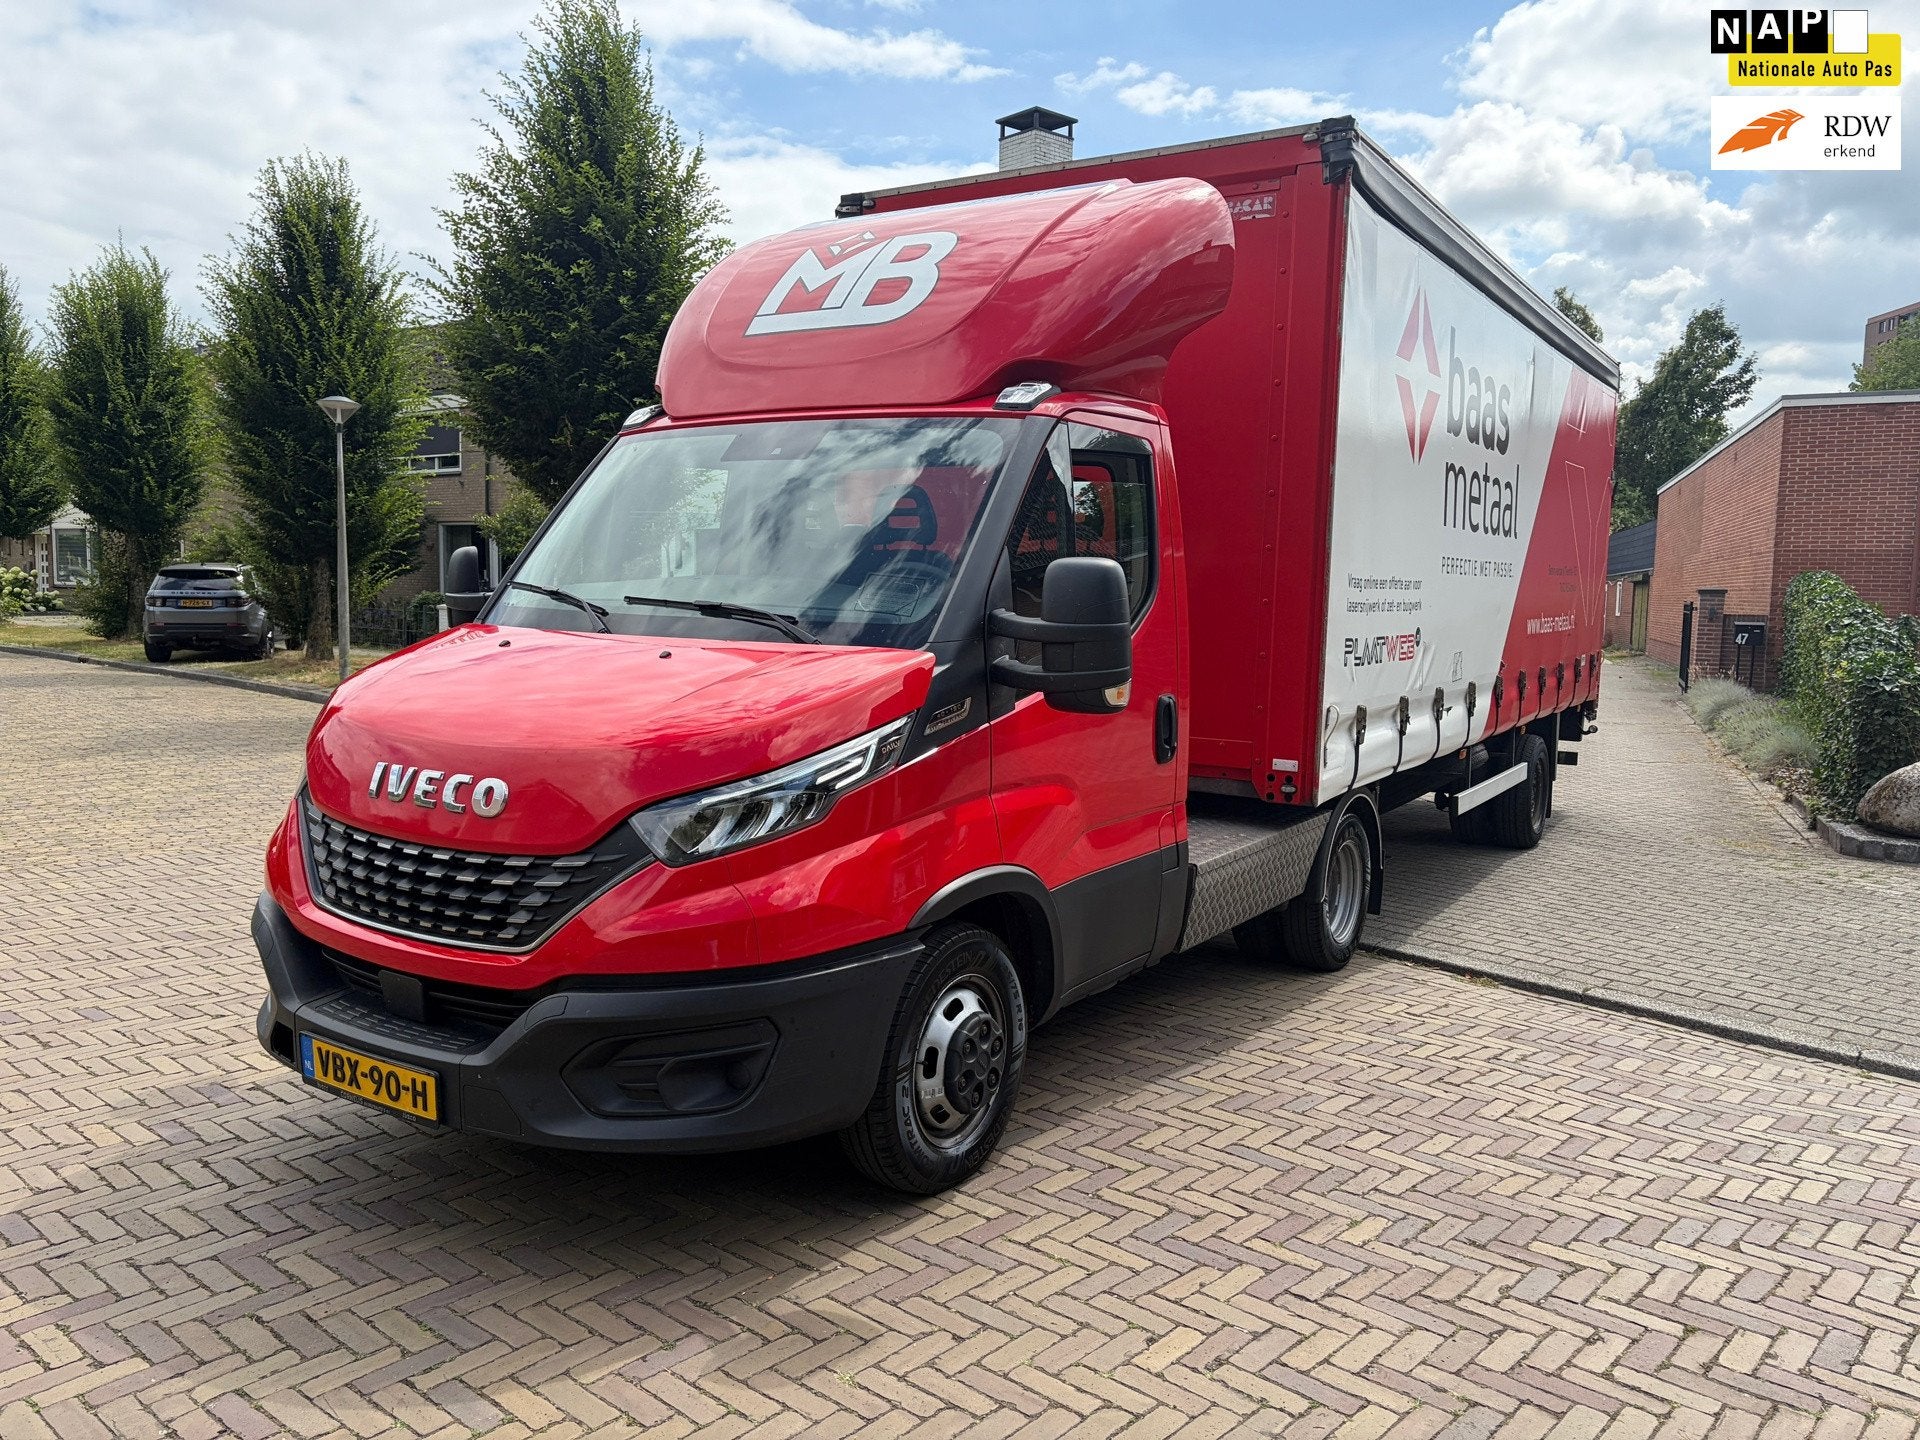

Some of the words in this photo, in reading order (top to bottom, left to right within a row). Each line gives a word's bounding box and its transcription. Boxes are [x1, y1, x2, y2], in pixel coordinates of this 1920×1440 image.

[743, 230, 959, 338] MB
[1446, 325, 1511, 456] baas
[1443, 460, 1520, 540] metaal
[1441, 556, 1478, 577] PERFECTIE
[1480, 560, 1492, 577] MET
[1347, 572, 1362, 593] Vraag
[1363, 575, 1379, 590] online
[1379, 578, 1388, 590] een
[1389, 576, 1403, 590] offerte
[1404, 580, 1412, 590] aan
[1526, 609, 1576, 635] www.baas-metaal.nl
[1343, 633, 1415, 668] PLAATWEB
[1735, 633, 1749, 645] 47
[881, 739, 901, 755] DAILY
[367, 761, 510, 819] IVECO
[304, 1059, 314, 1071] NL
[316, 1046, 428, 1112] VBX-90-H
